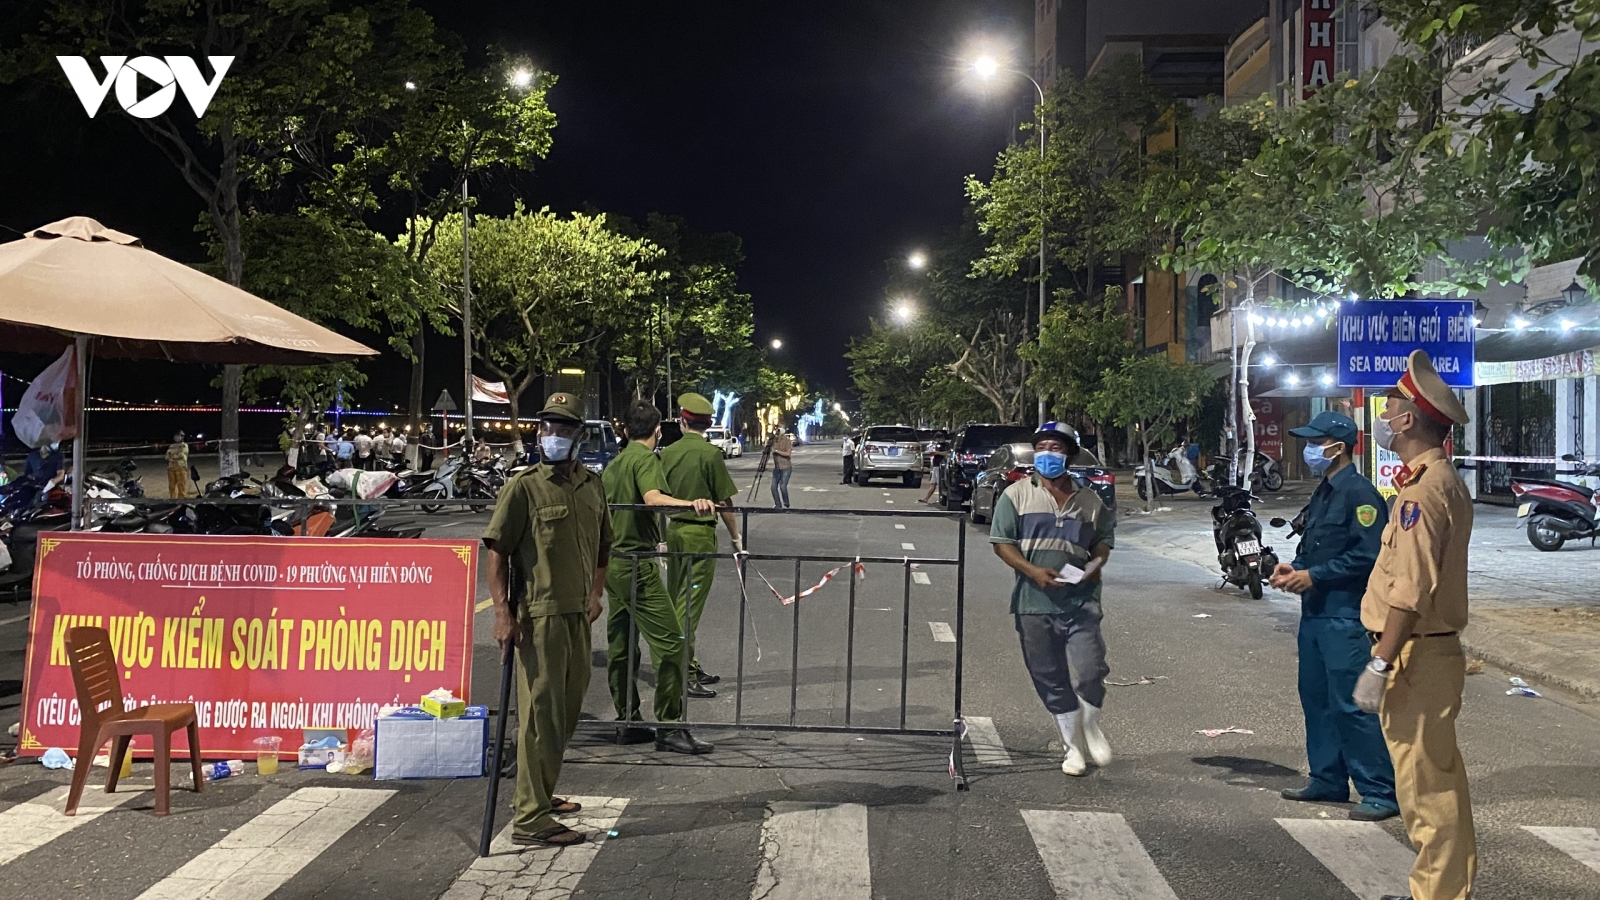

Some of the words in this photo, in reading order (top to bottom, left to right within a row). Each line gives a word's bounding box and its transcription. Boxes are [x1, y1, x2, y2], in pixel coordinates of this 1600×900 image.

[1342, 315, 1365, 342] KHU
[1368, 310, 1389, 345] VỰC
[1392, 310, 1416, 342] BIÊN
[1419, 305, 1440, 343] GIỚI
[1447, 304, 1471, 343] BIỂN
[1349, 356, 1371, 373] SEA
[1374, 356, 1408, 373] BOUND
[1432, 356, 1460, 373] AREA
[77, 551, 92, 579] TỔ
[93, 556, 136, 583] PHÒNG,
[138, 553, 178, 581] CHỐNG
[180, 565, 208, 588] DỊCH
[210, 559, 241, 588] BỆNH
[243, 565, 278, 583] COVID
[286, 565, 298, 583] 19
[300, 561, 347, 584] PHƯỜNG
[348, 566, 369, 589] NẠI
[370, 561, 399, 583] HIÊN
[400, 561, 433, 584] ĐÔNG
[161, 596, 225, 669] KIỂM
[230, 607, 294, 670] SOÁT
[298, 606, 382, 671] PHÒNG
[388, 620, 447, 683] DỊCH
[37, 692, 67, 728] (YÊU
[214, 699, 248, 734] ĐƯỢC
[250, 702, 267, 728] RA
[270, 697, 310, 729] NGOÀI
[312, 703, 334, 728] KHI
[336, 697, 378, 730] KHÔNG
